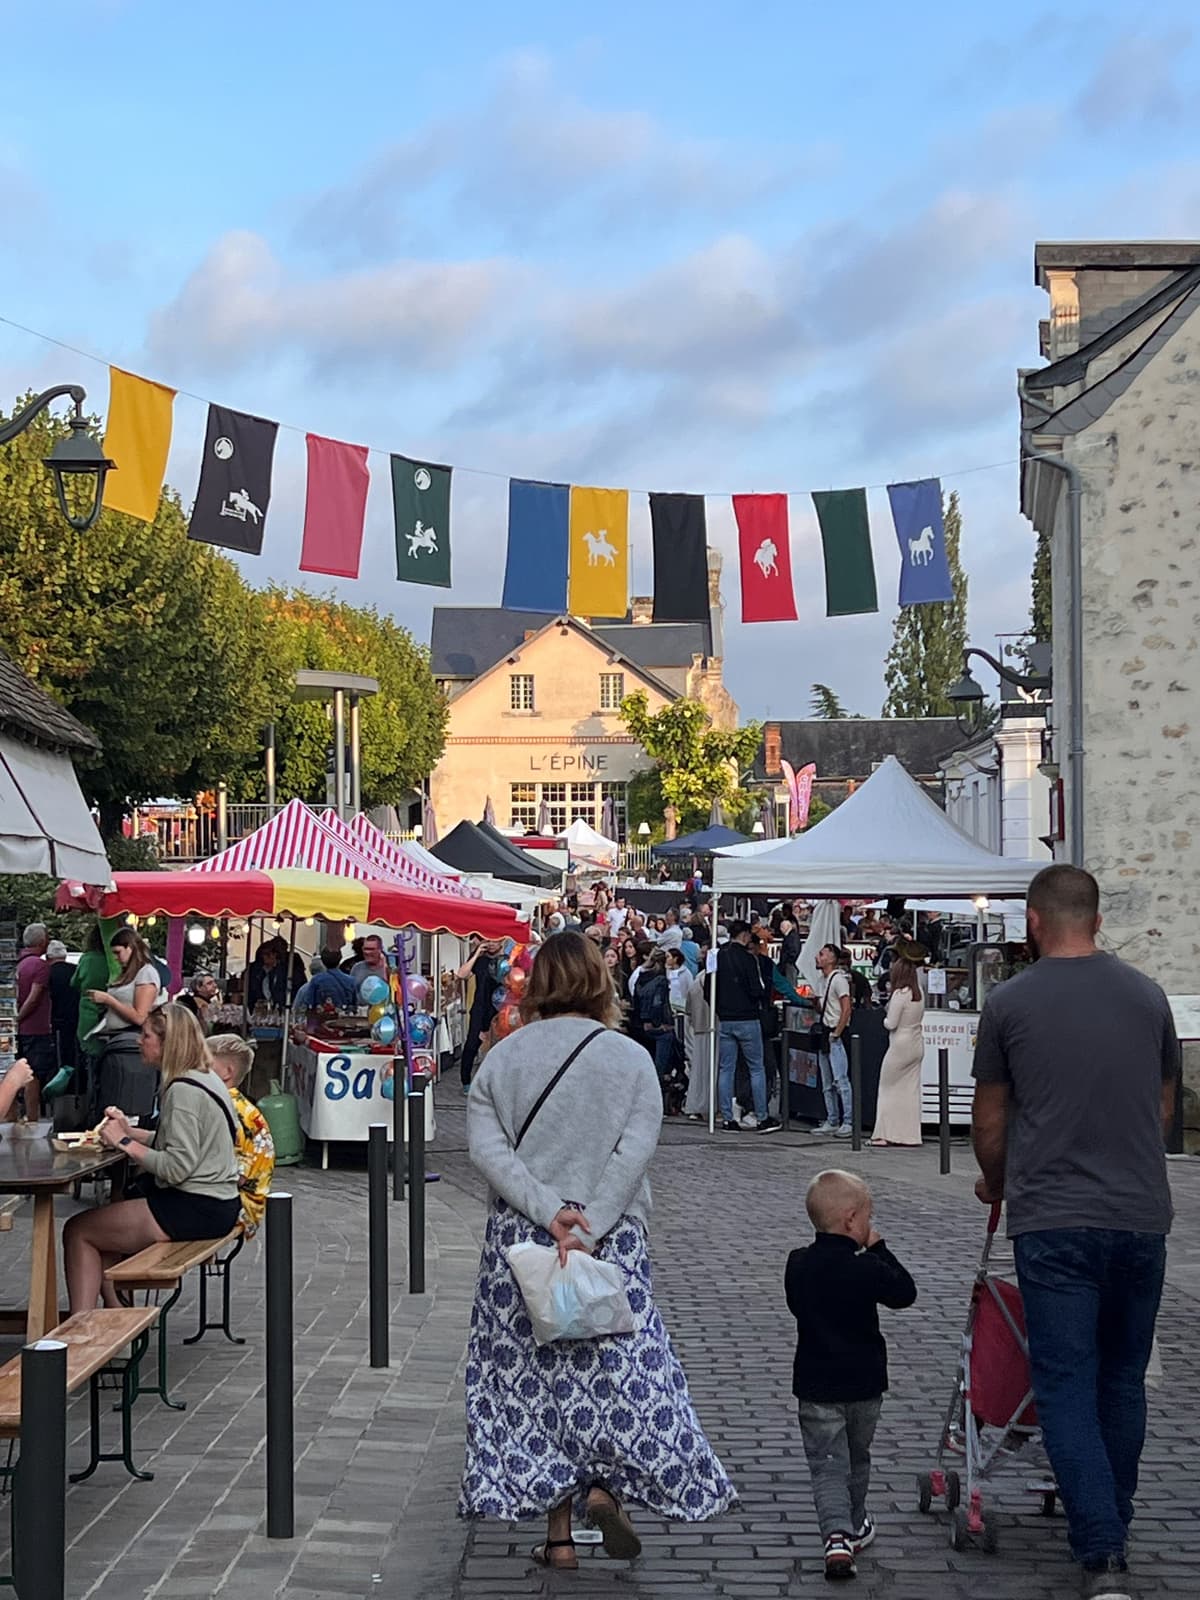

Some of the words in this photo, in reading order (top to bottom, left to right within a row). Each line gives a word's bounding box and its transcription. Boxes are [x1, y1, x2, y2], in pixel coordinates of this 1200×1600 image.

[530, 752, 608, 770] L'ÉPINE
[852, 948, 874, 961] UR
[324, 1054, 387, 1101] Sa
